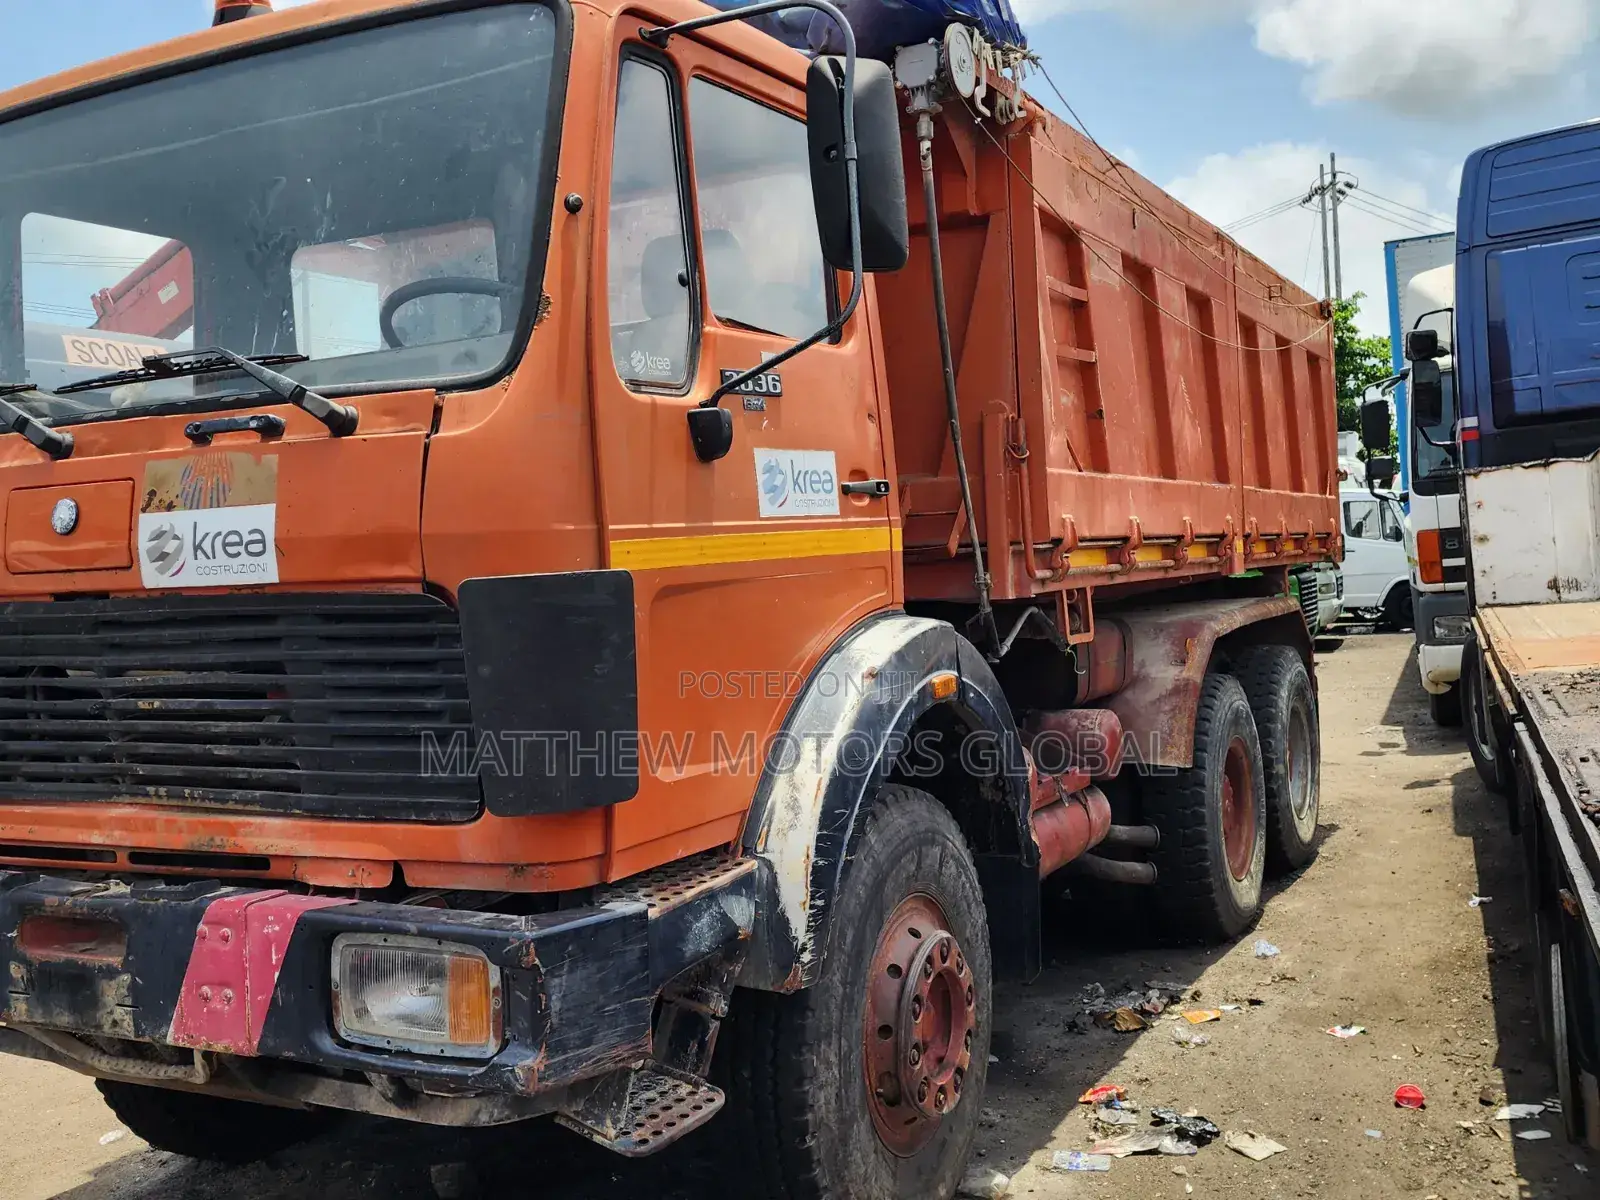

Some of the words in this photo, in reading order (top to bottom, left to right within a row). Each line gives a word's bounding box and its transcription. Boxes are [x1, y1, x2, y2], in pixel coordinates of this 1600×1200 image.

[646, 351, 671, 370] krea
[790, 459, 834, 494] krea
[192, 521, 267, 560] krea
